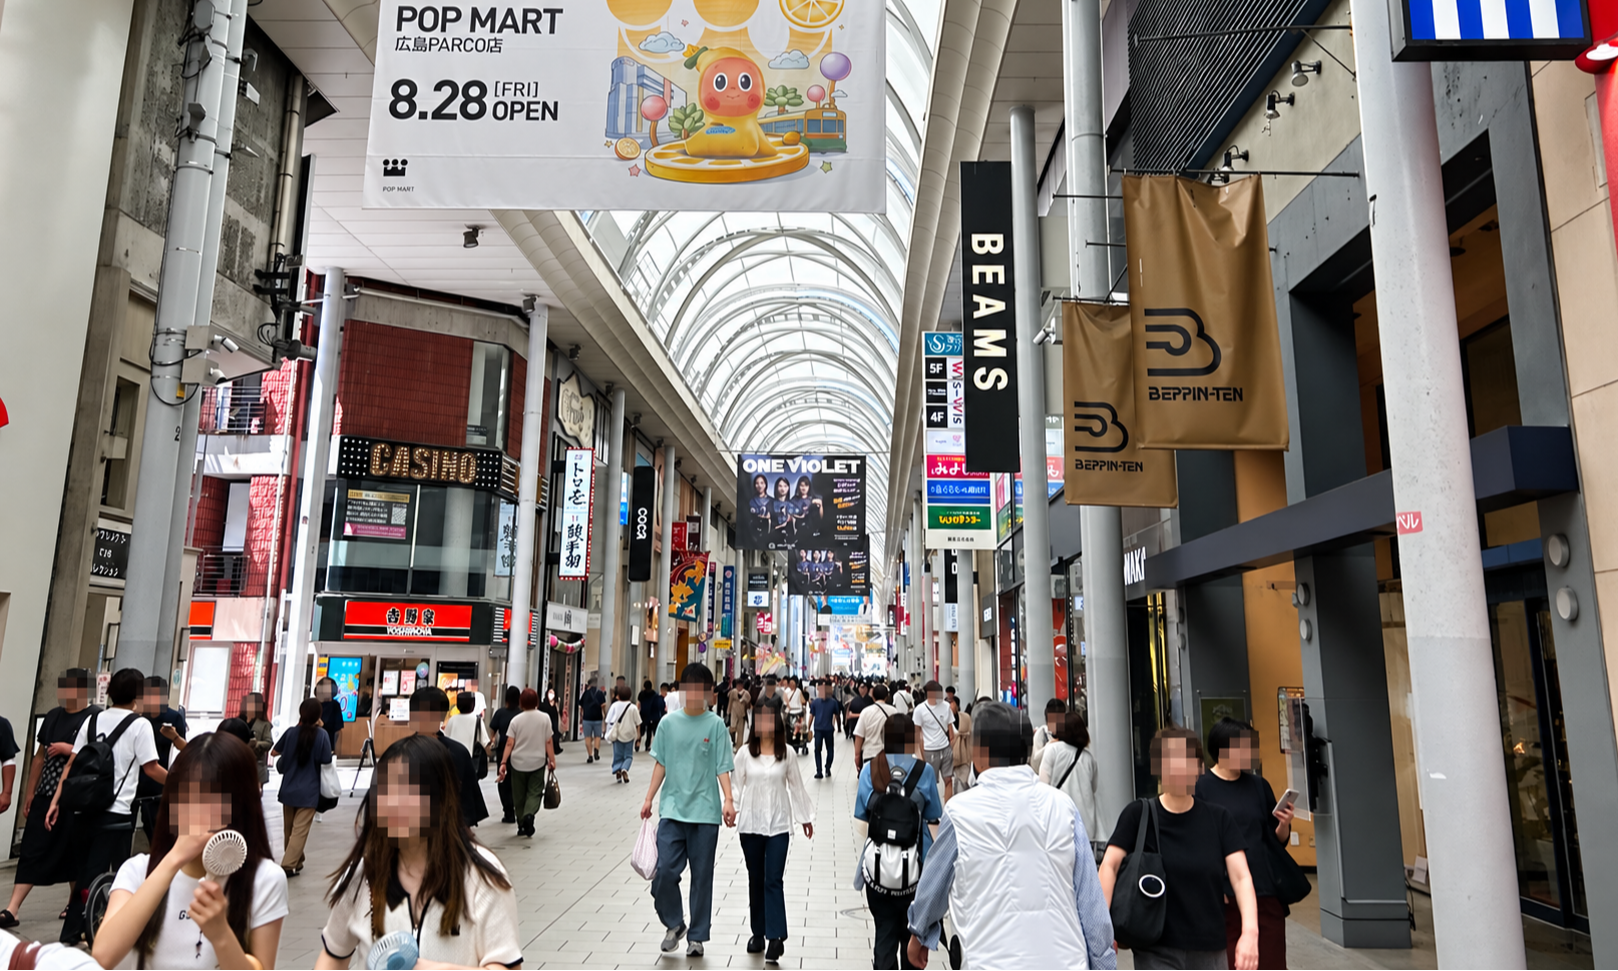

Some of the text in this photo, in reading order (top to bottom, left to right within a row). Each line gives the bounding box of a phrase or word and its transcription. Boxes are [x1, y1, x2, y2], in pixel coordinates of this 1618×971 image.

[396, 6, 563, 34] POP MART
[395, 36, 503, 53] 広島PARCO店
[389, 79, 488, 120] 8.28
[492, 101, 558, 121] OPEN
[971, 233, 1009, 391] BEAMS
[930, 363, 943, 374] 5F
[1148, 386, 1243, 401] BEPPIN-TEN
[930, 411, 944, 422] 4F
[370, 443, 477, 484] CASINO
[742, 456, 861, 474] ONE VIOLET
[1075, 459, 1143, 472] BEPPIN-TEN
[386, 606, 435, 626] 吉野家
